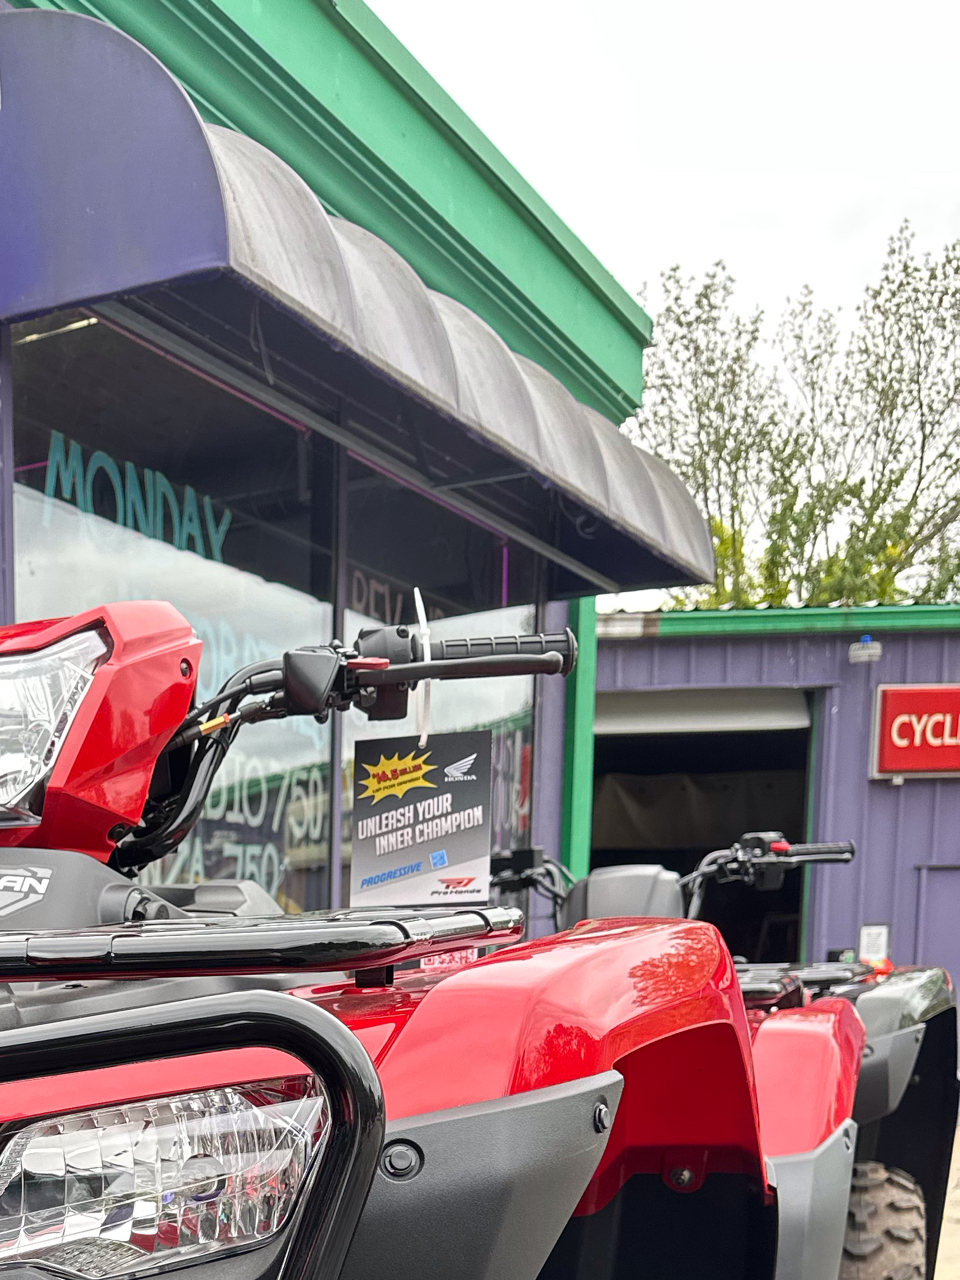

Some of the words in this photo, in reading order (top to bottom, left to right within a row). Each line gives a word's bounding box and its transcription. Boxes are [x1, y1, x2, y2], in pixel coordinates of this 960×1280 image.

[43, 430, 233, 563] MONDAY
[891, 713, 960, 748] CYCL
[444, 775, 477, 783] HONDA
[358, 804, 414, 840] UNLEASH
[416, 793, 452, 822] YOUR
[375, 827, 413, 856] INNER
[415, 805, 483, 844] CHAMPION
[360, 861, 423, 889] PROGRESSIVE
